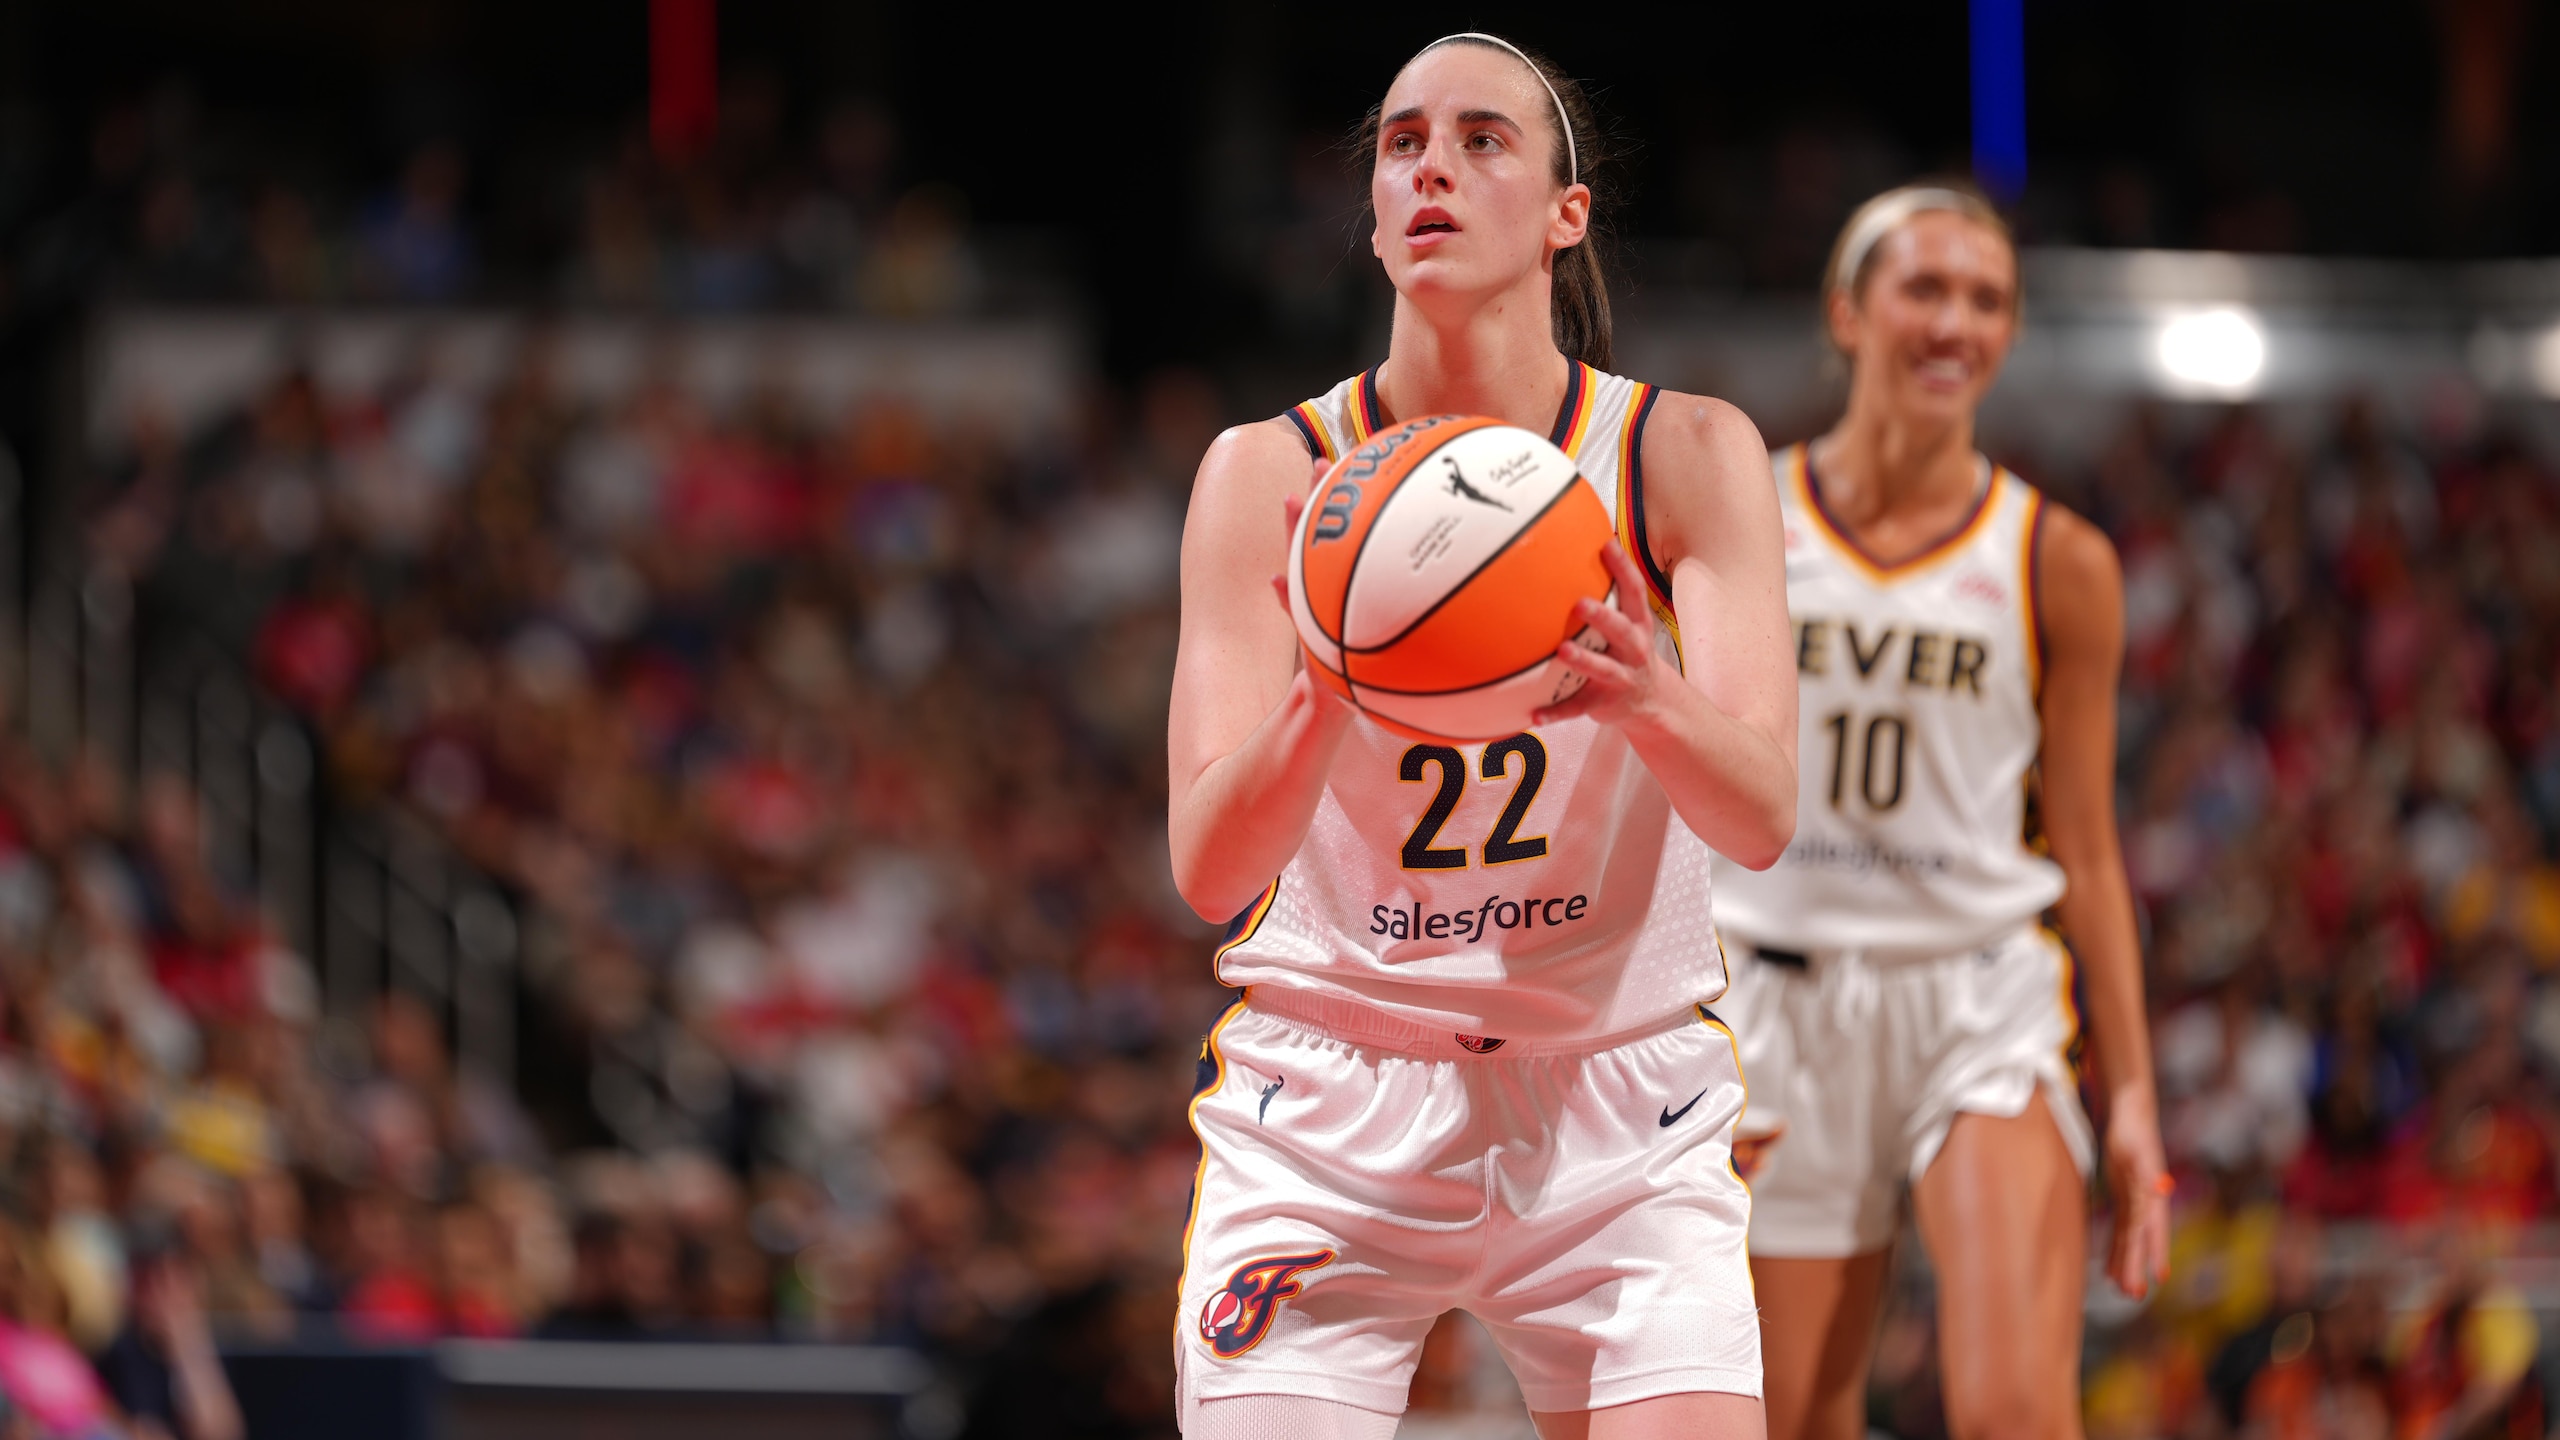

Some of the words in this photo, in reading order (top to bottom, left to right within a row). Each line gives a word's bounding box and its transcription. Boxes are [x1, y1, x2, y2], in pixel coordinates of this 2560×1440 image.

[1792, 616, 1992, 700] EVER
[1397, 730, 1549, 871] 22
[1821, 708, 1918, 820] 10
[1369, 894, 1588, 944] salesforce
